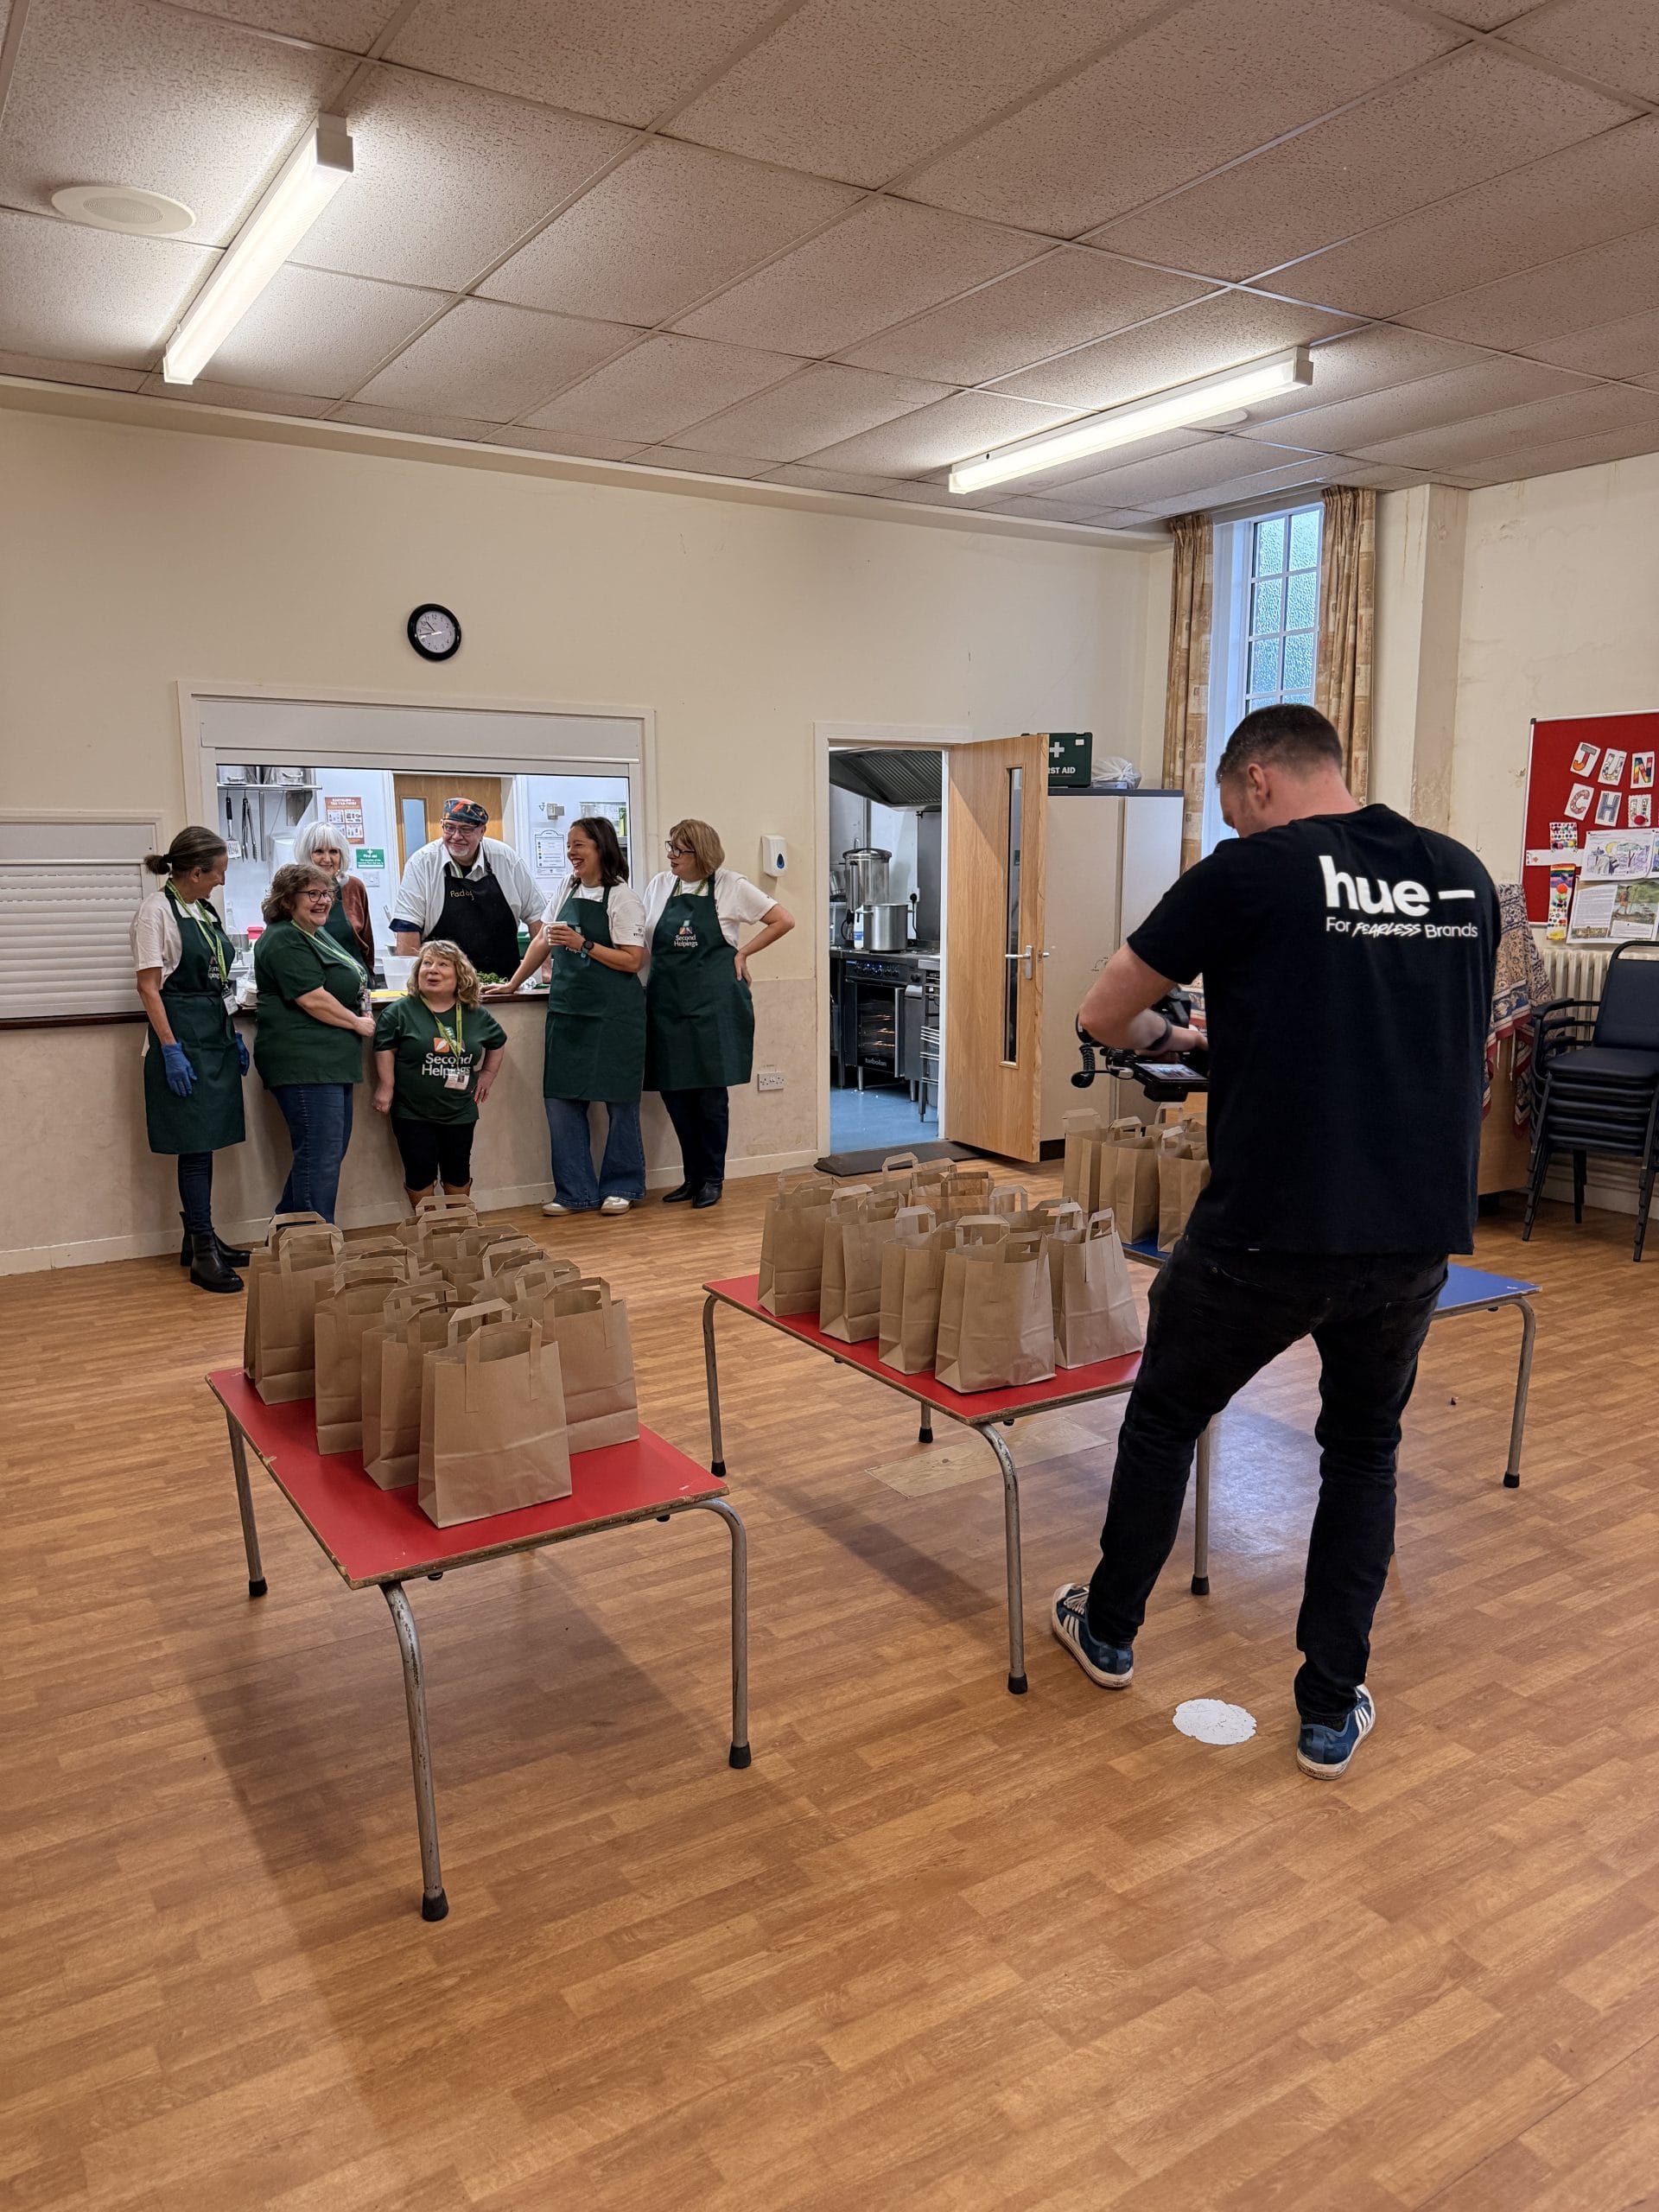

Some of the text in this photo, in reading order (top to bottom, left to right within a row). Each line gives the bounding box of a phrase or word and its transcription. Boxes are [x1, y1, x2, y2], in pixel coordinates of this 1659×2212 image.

[1325, 917, 1478, 938] For FEARLESS Brands
[425, 1052, 474, 1065] Second
